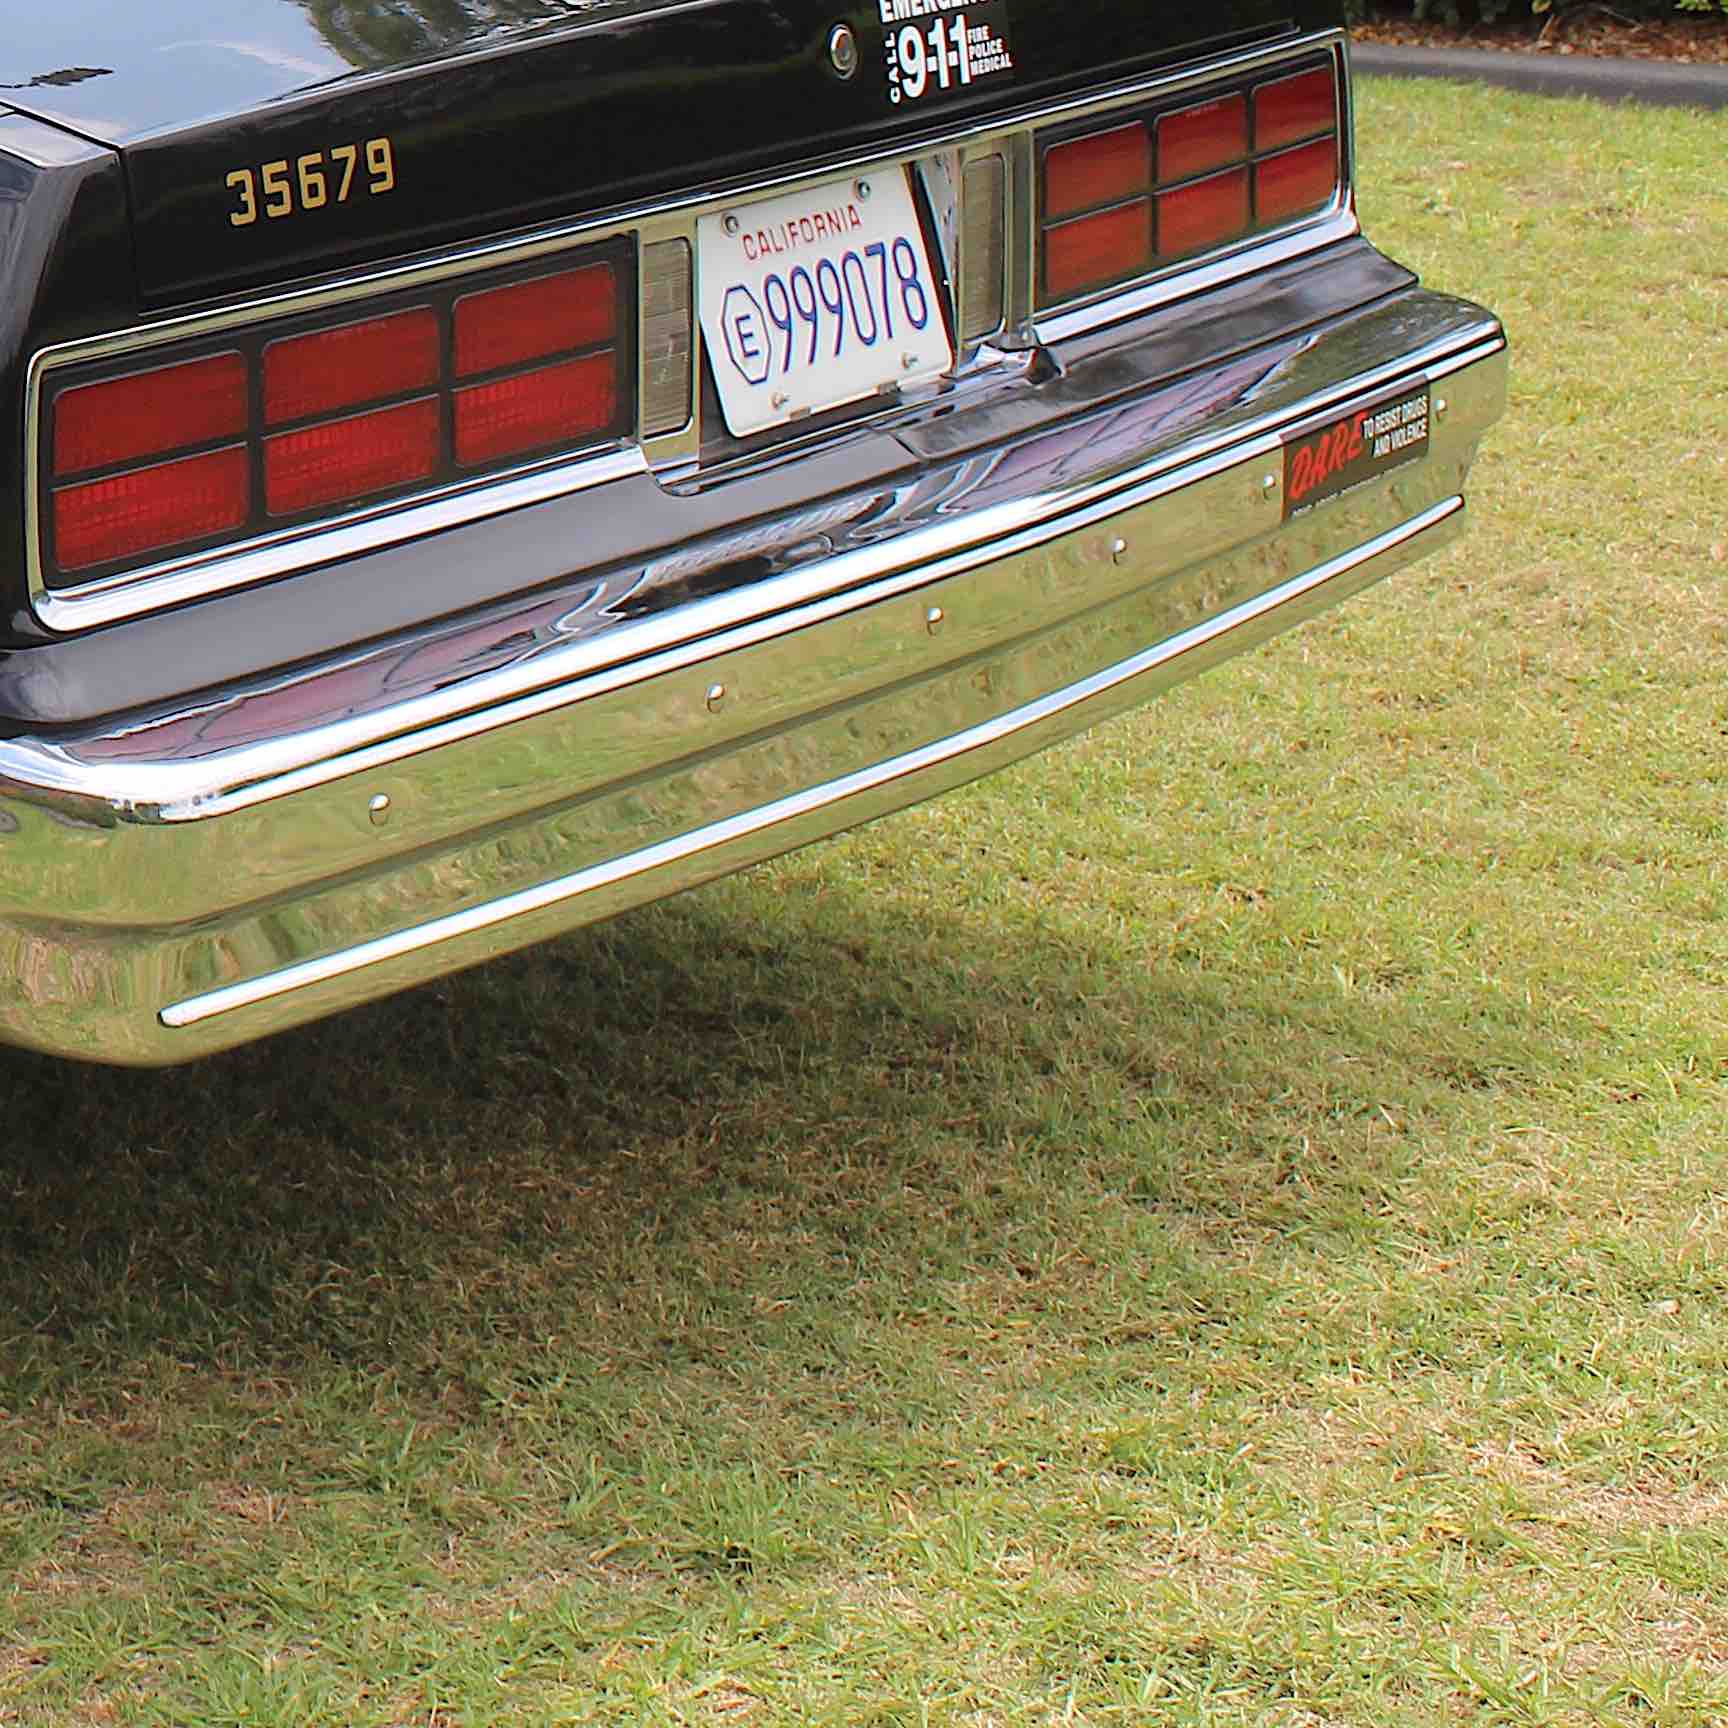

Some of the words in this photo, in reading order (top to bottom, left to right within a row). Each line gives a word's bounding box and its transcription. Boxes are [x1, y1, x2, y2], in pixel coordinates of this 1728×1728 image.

[967, 24, 990, 45] FIRE
[968, 38, 1004, 61] POLICE
[884, 31, 902, 104] CALL
[970, 52, 1014, 76] MEDICAL
[226, 136, 394, 227] 35679
[742, 203, 862, 261] CALIFORNIA
